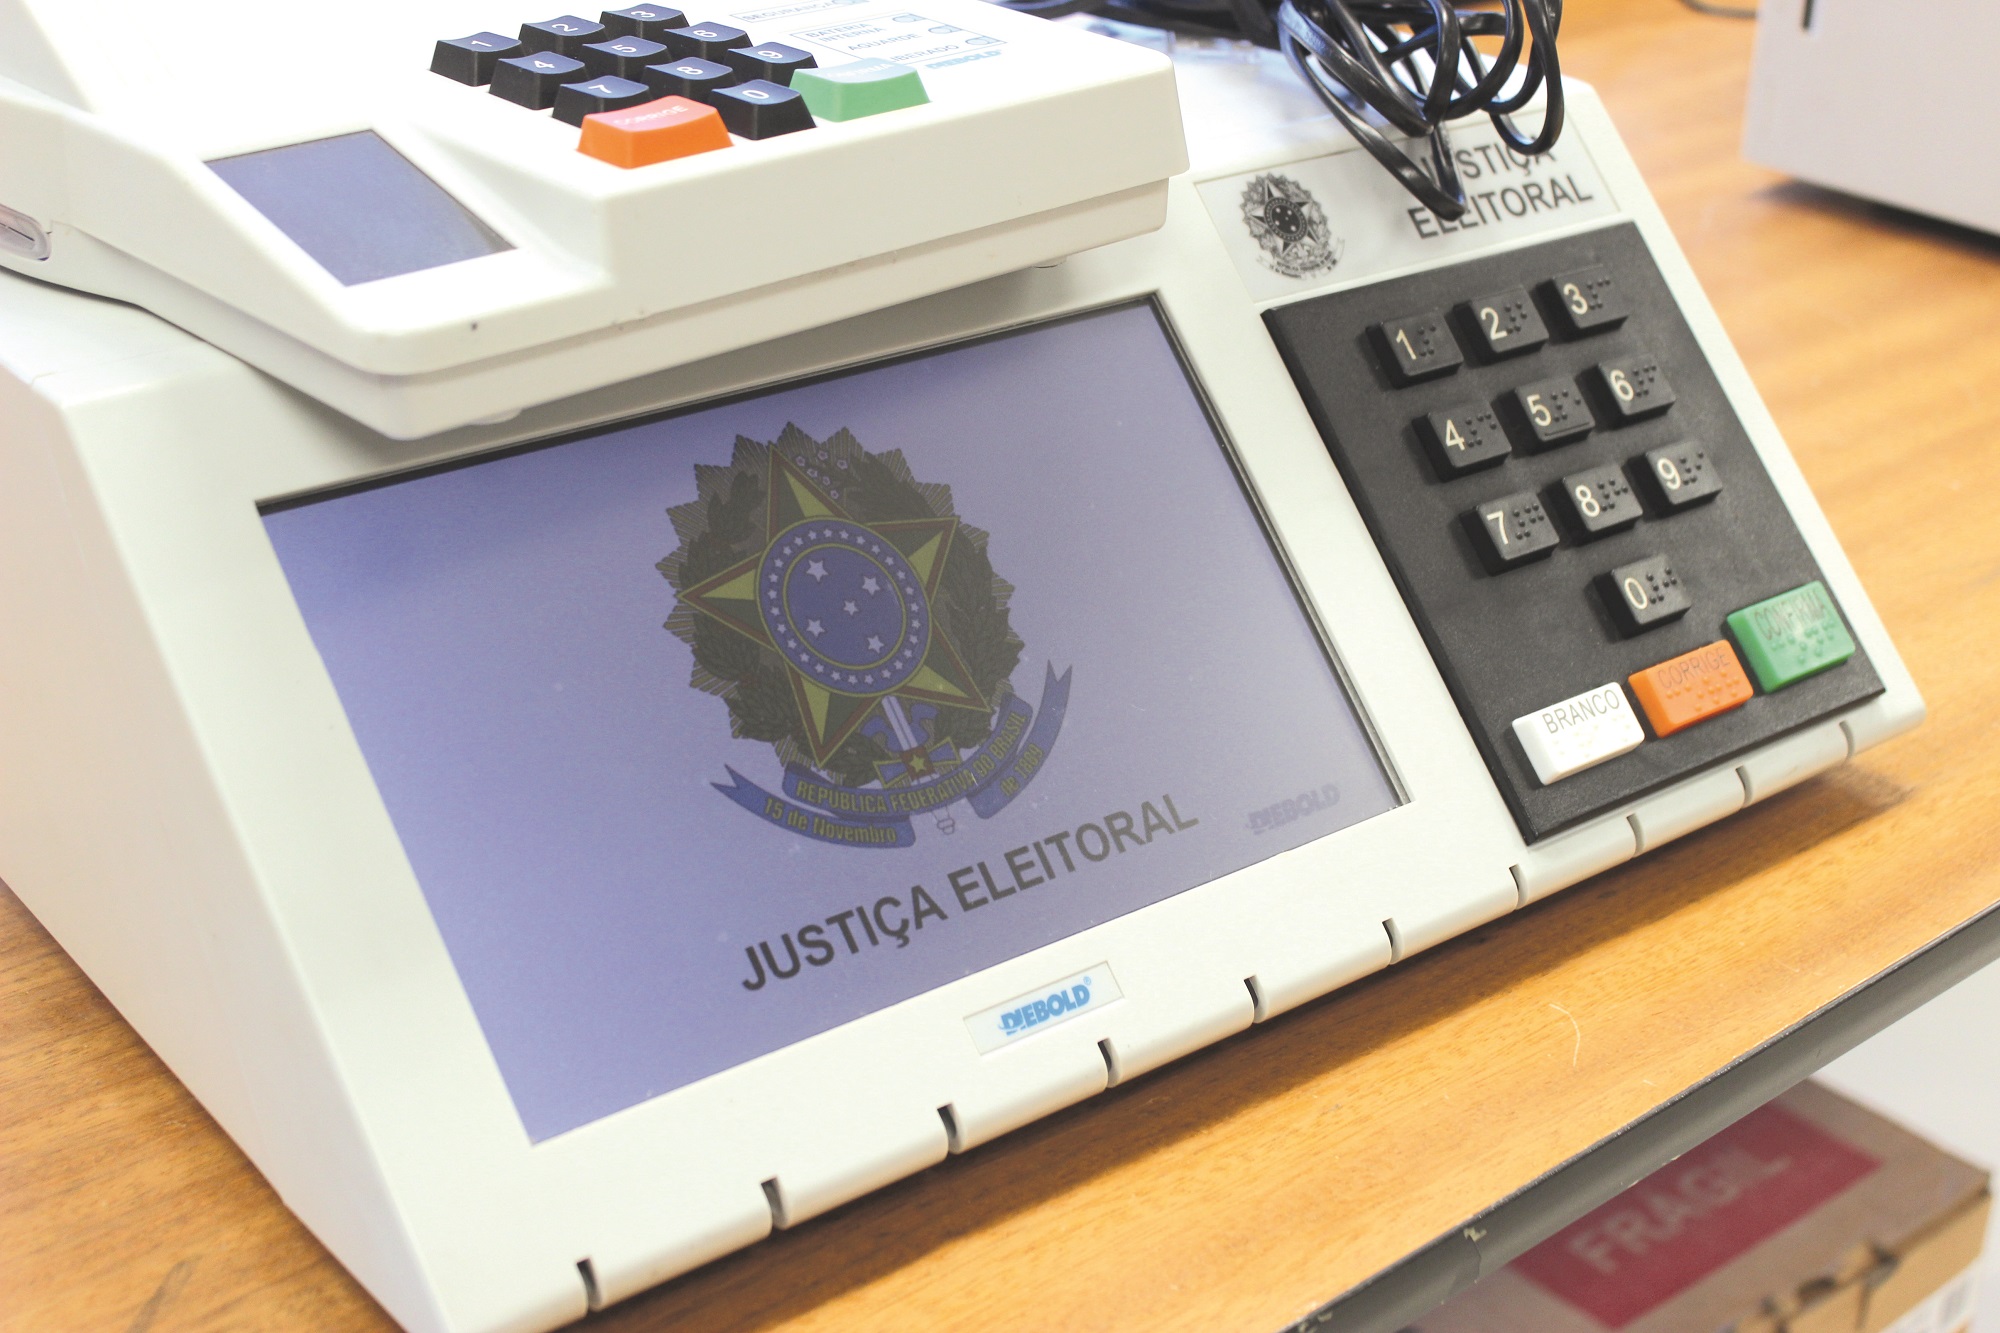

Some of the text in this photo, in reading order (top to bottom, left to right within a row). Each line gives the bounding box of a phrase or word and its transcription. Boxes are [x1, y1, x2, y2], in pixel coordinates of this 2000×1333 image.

[551, 23, 579, 32] 2
[631, 10, 655, 18] 3
[471, 39, 492, 48] 1
[693, 29, 718, 38] 6
[805, 23, 873, 39] BATERIA
[819, 27, 887, 43] INTERNA
[848, 33, 922, 51] AGUARDE
[533, 60, 555, 69] 4
[611, 44, 637, 53] 5
[757, 50, 784, 60] 9
[676, 66, 704, 76] 8
[588, 84, 613, 94] 7
[1563, 283, 1589, 315] 3
[1480, 307, 1508, 341] 2
[1396, 329, 1417, 361] 1
[1610, 369, 1635, 401] 6
[1526, 394, 1552, 427] 5
[1445, 419, 1467, 452] 4
[1657, 457, 1682, 491] 9
[1575, 484, 1600, 517] 8
[1486, 510, 1509, 544] 7
[1624, 577, 1648, 610] 0
[1657, 646, 1732, 690] CORRIGE
[1542, 689, 1620, 735] BRANCO
[889, 770, 978, 814] FEDERATIVA
[971, 757, 997, 781] DO
[989, 710, 1027, 767] BRASIL
[1000, 778, 1020, 798] de
[764, 797, 897, 844] 15 de Novembro
[1245, 783, 1341, 835] DIEBOLD
[741, 793, 1200, 992] JUSTIÇA ELEITORAL
[997, 982, 1091, 1038] DIEBOLD
